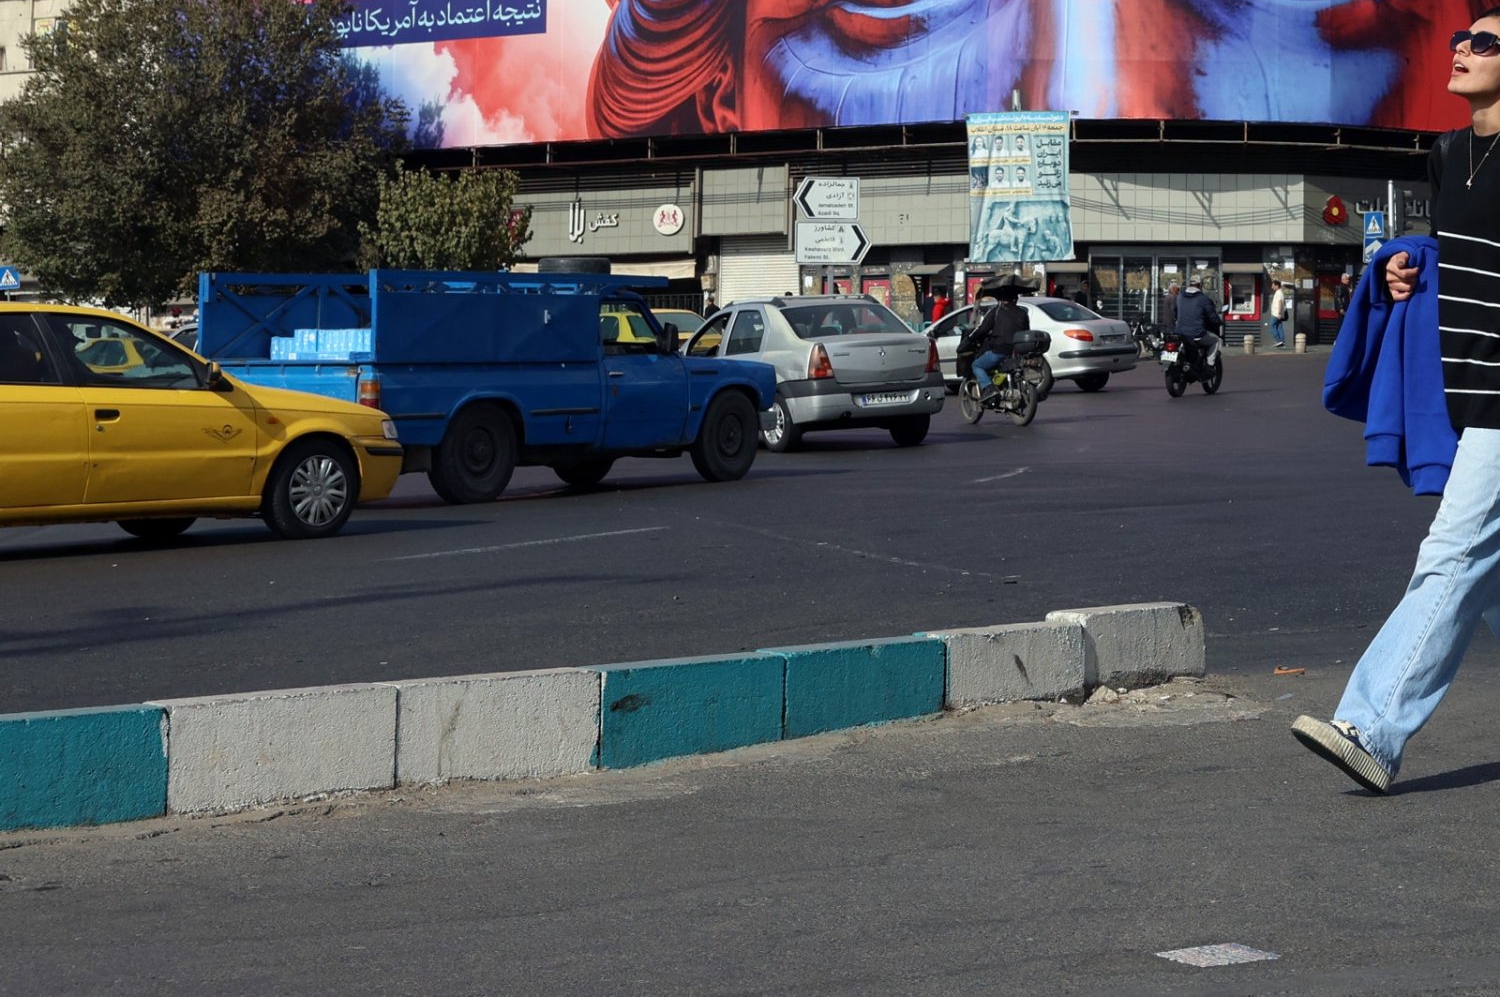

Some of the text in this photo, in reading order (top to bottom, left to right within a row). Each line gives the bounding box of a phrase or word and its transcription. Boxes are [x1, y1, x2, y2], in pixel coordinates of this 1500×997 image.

[364, 0, 419, 37] آمریکا
[418, 11, 434, 33] به
[493, 0, 542, 26] نتیجه
[1036, 138, 1062, 149] مقابل
[1037, 149, 1062, 158] ایران
[589, 212, 618, 231] کفش
